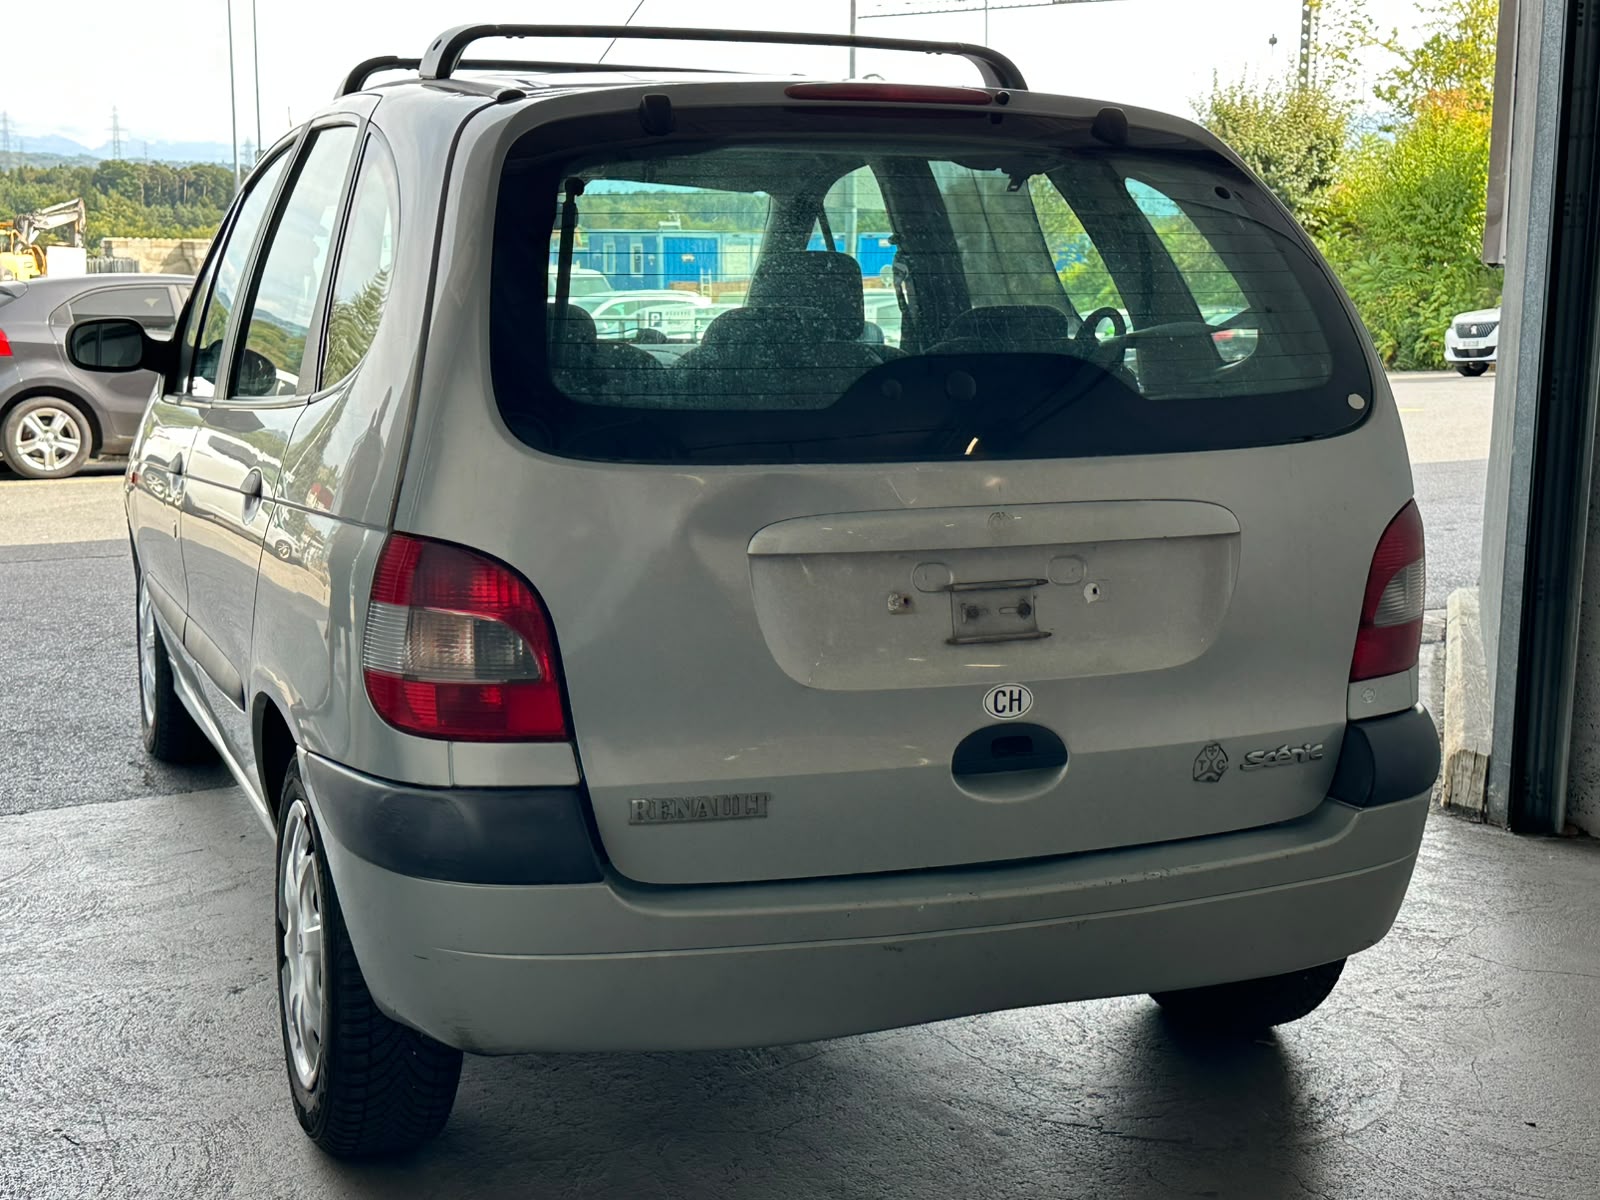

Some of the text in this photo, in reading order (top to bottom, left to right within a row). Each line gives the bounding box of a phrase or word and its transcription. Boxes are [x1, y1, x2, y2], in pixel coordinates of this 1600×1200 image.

[650, 312, 661, 327] P
[994, 689, 1022, 714] CH
[628, 791, 772, 826] RENAULT
